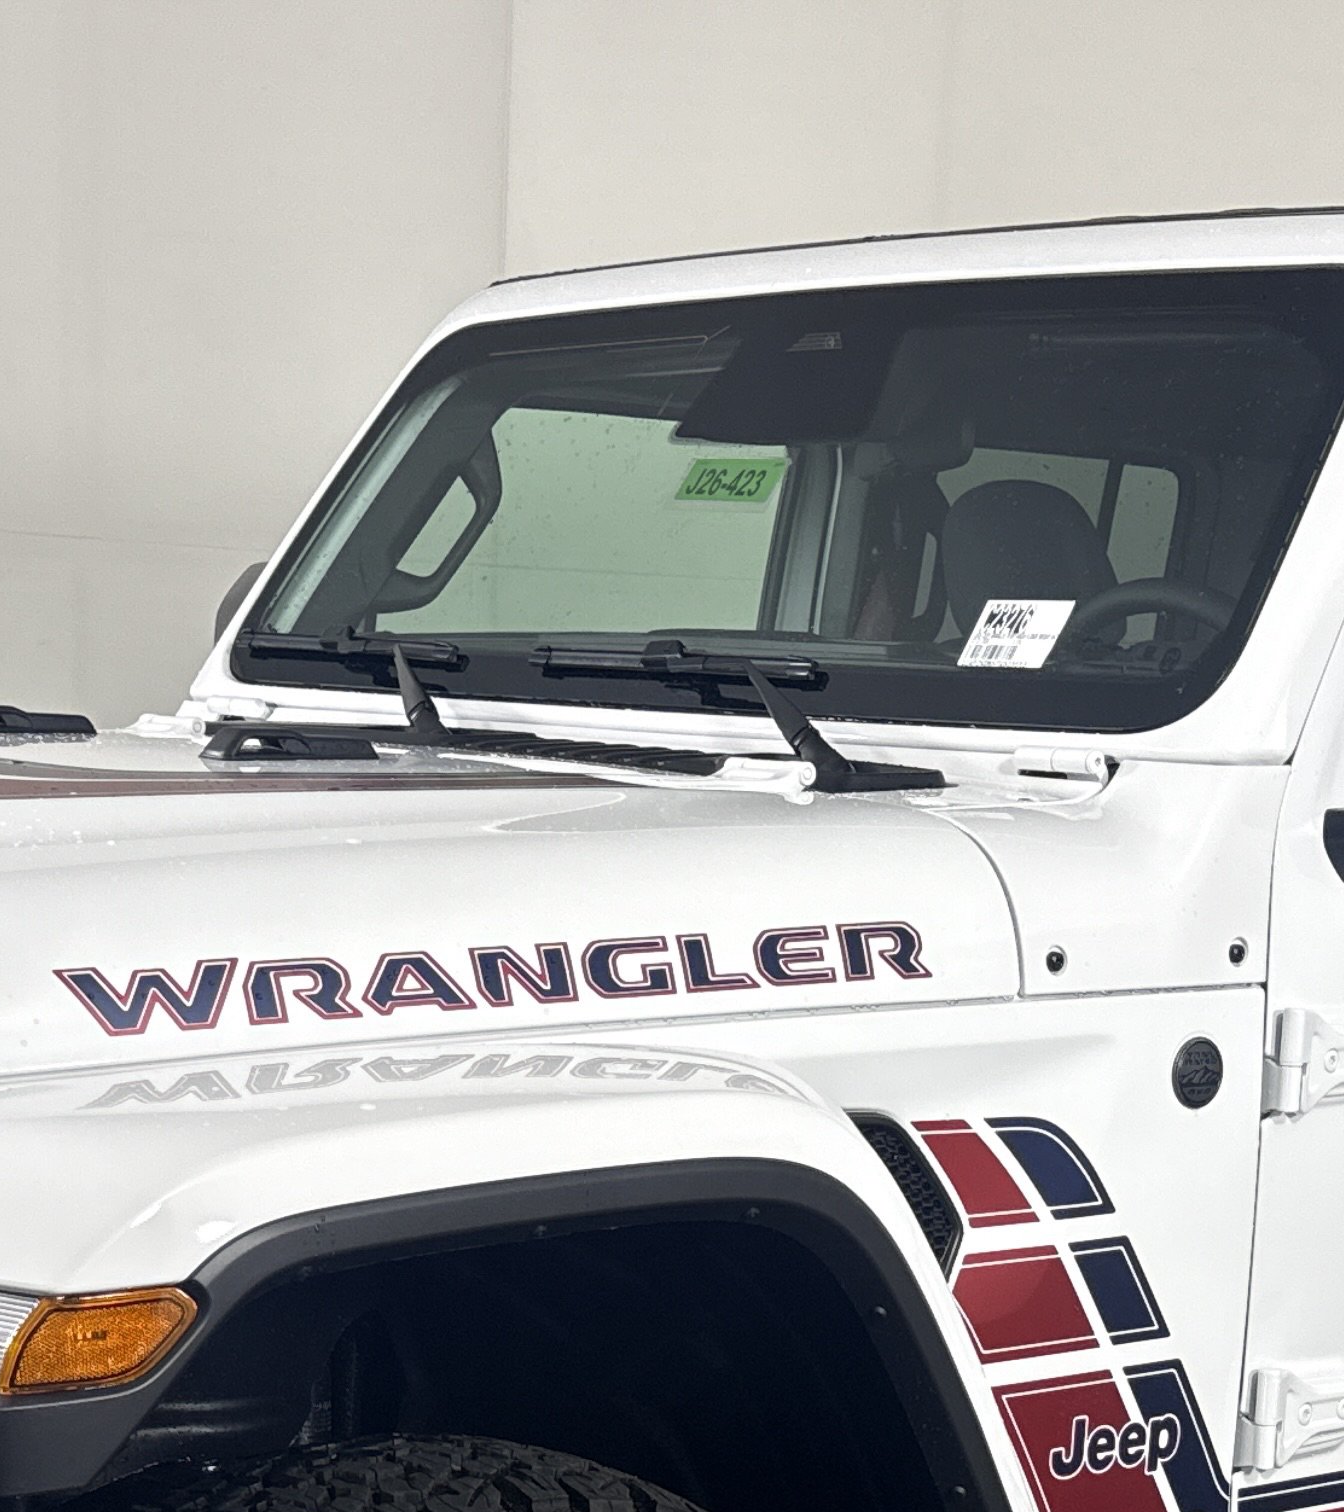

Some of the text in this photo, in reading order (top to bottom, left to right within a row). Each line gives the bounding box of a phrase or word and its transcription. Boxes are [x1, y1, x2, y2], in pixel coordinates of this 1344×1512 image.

[684, 468, 767, 497] J26-423
[52, 921, 933, 1036] WRANGLER
[1049, 1413, 1180, 1479] Jeep
